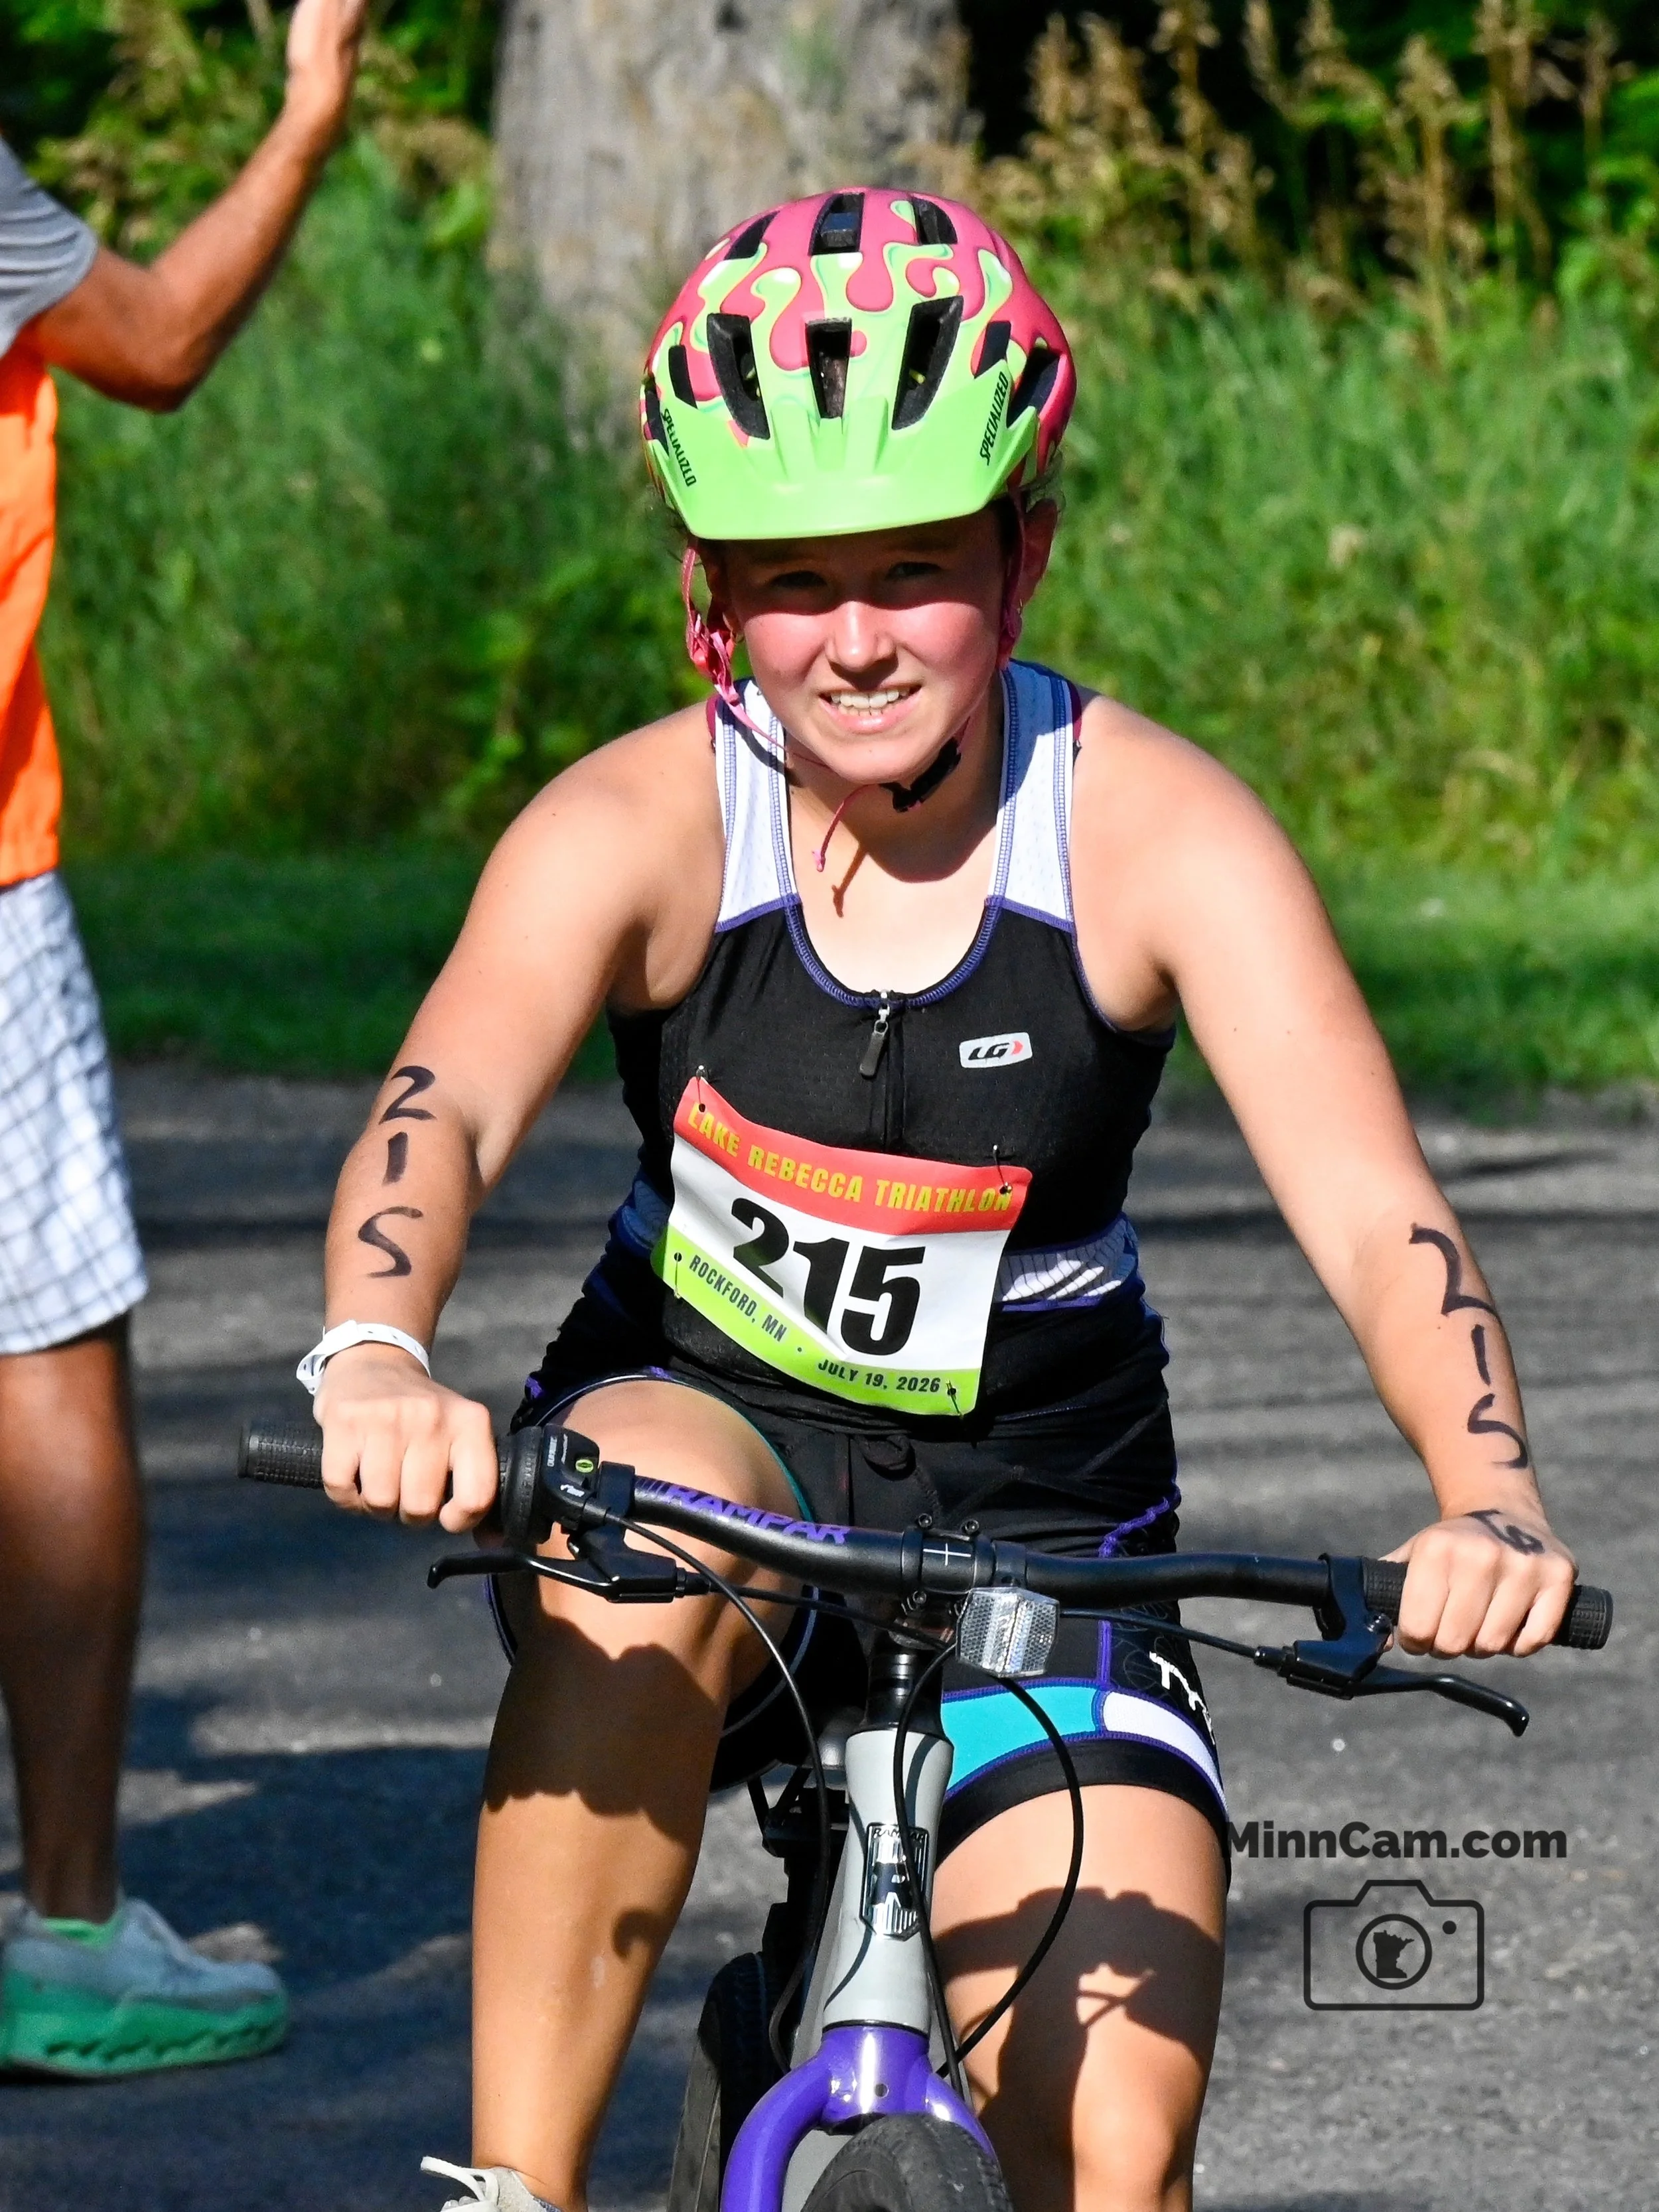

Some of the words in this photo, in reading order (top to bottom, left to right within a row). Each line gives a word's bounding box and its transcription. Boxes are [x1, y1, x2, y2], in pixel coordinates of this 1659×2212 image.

[662, 408, 697, 487] SPECIALIZED
[979, 371, 1009, 466] SPECIALIZED
[687, 1102, 741, 1158] LAKE
[747, 1144, 863, 1203] REBECCA
[875, 1179, 1013, 1213] TRIATHLON
[731, 1198, 926, 1355] 215
[761, 1314, 787, 1342] MN
[818, 1359, 859, 1382] JULY
[897, 1377, 941, 1393] 2026
